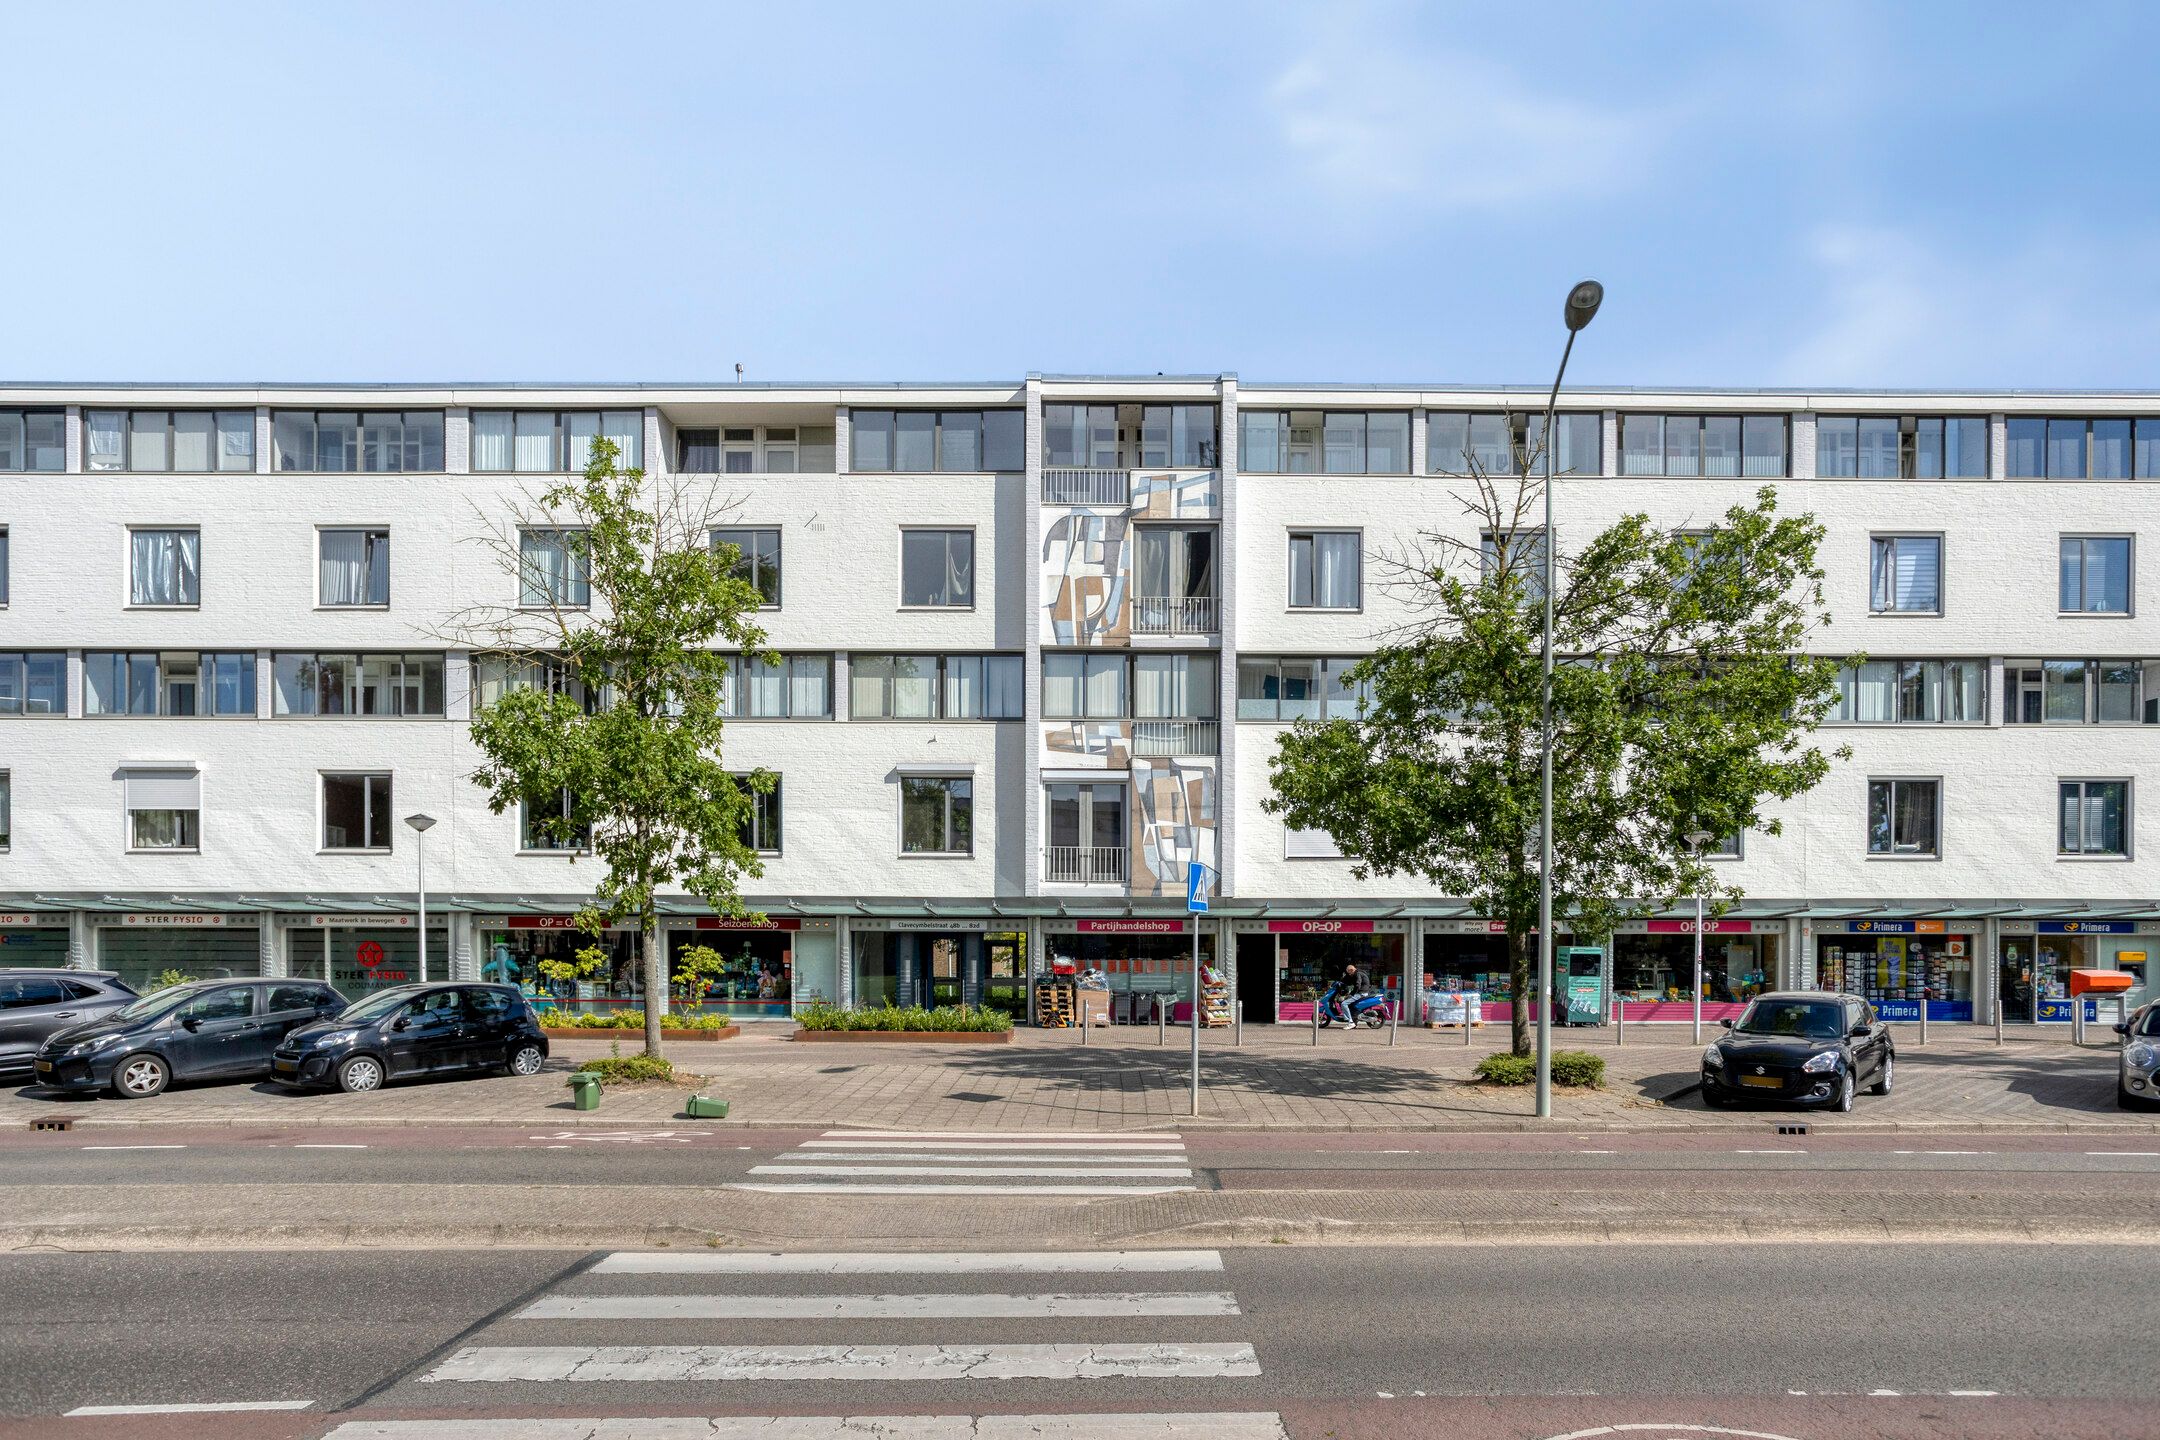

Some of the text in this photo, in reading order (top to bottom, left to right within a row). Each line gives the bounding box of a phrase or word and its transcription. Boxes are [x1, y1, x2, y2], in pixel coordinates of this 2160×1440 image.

[539, 917, 554, 927] OP
[898, 921, 948, 929] Clavecymbelstraat
[1091, 921, 1170, 931] Partijhandelshop
[1302, 921, 1342, 932] OP=OP
[1680, 921, 1719, 932] OPOP
[1873, 922, 1903, 932] Primera
[2080, 922, 2111, 932] Primera
[335, 971, 406, 980] STER FYSIO
[348, 982, 393, 990] COUMANS
[1882, 1005, 1918, 1017] Primera
[2059, 1005, 2095, 1017] Prira
